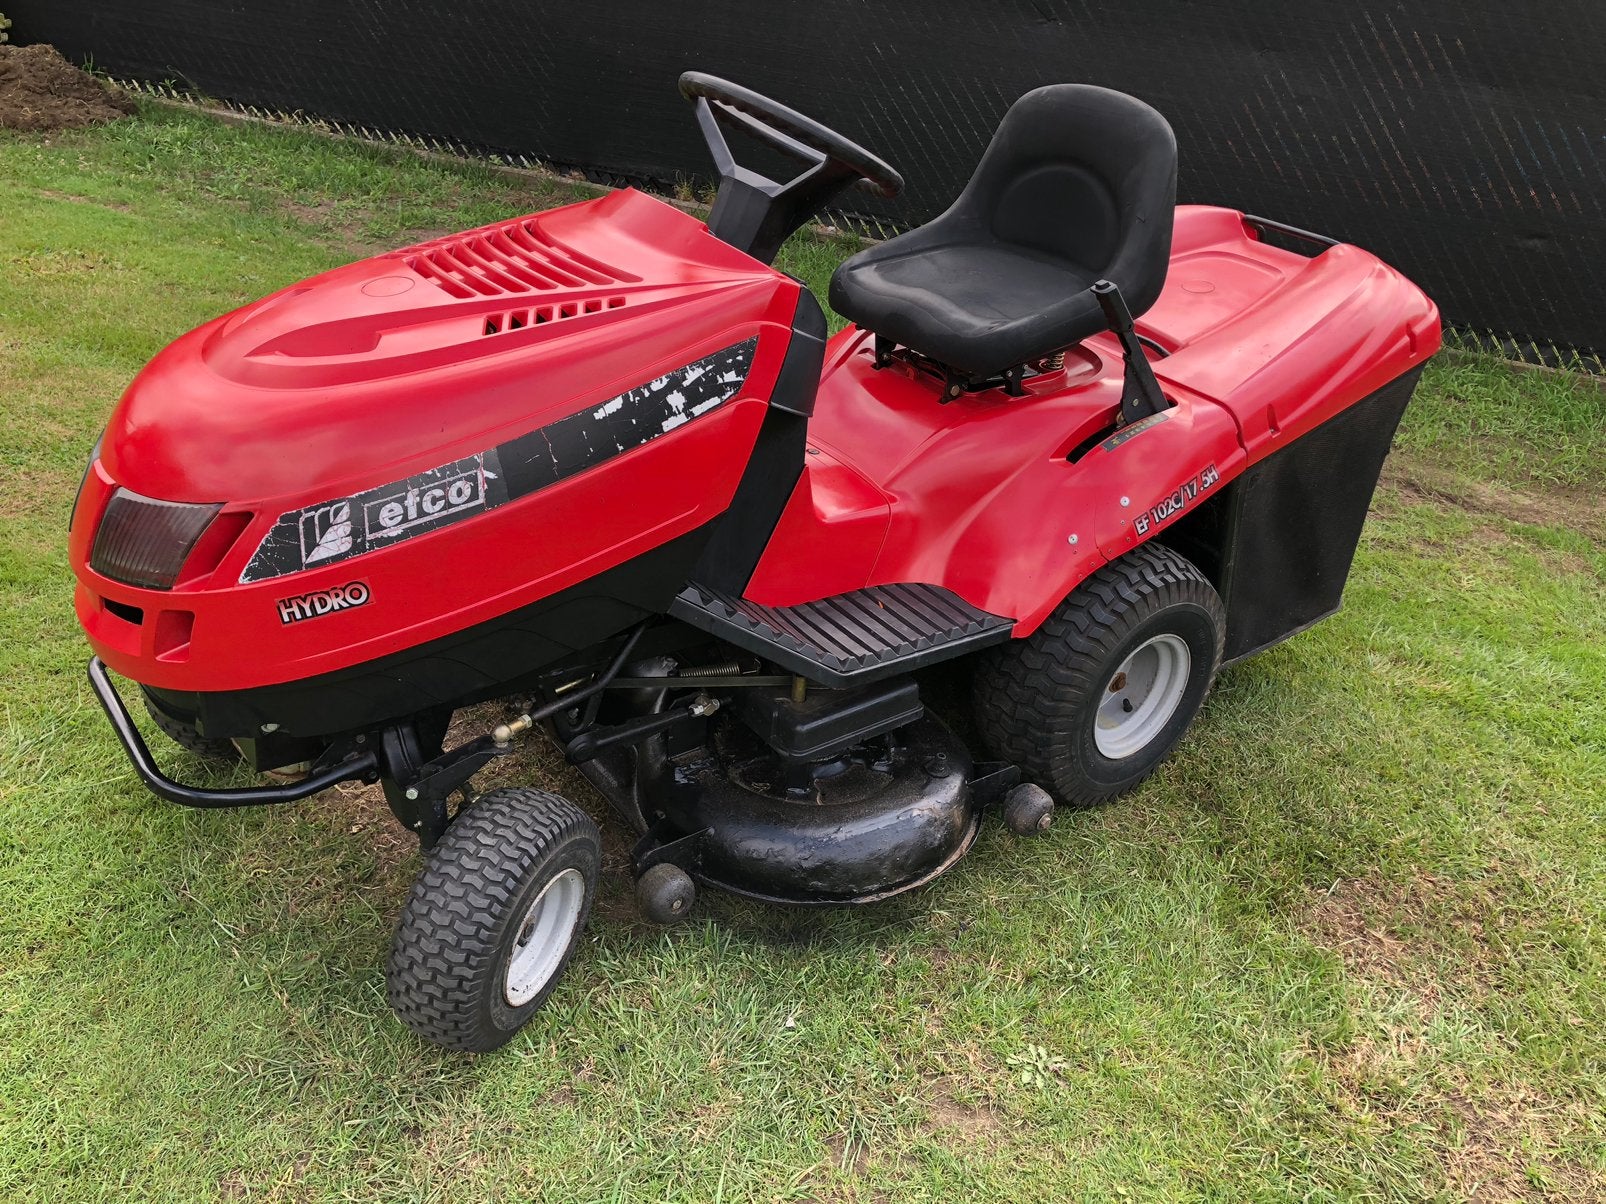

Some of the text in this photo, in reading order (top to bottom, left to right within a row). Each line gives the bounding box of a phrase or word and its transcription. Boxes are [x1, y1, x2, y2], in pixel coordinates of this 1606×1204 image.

[379, 480, 472, 528] efco
[1134, 513, 1150, 535] EF
[279, 581, 369, 623] HYDRO
